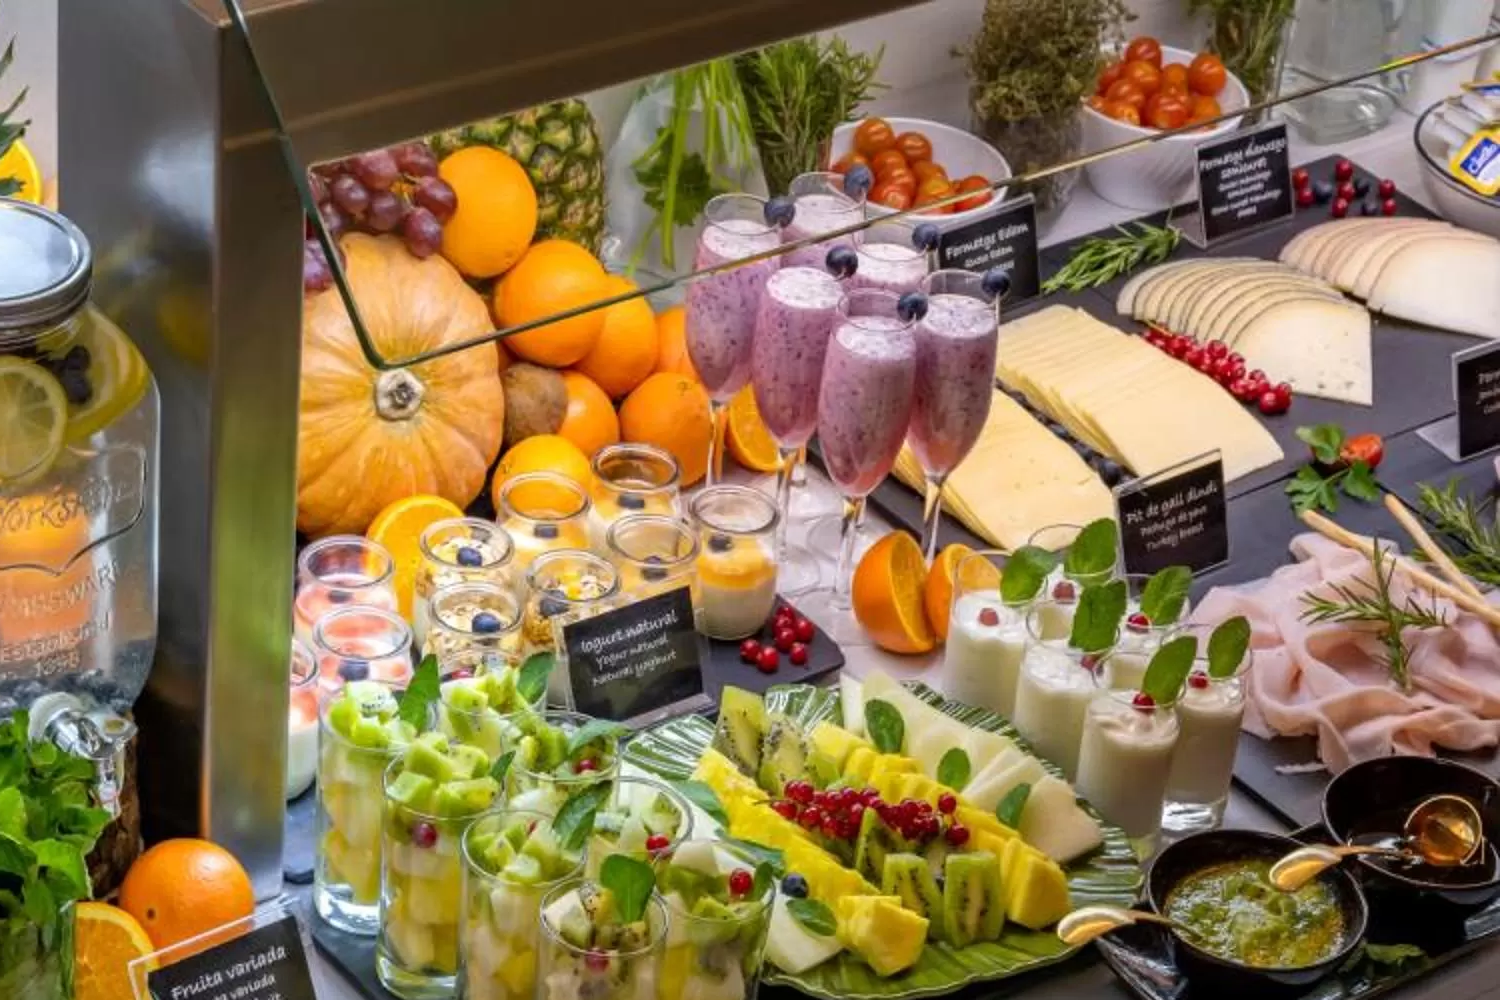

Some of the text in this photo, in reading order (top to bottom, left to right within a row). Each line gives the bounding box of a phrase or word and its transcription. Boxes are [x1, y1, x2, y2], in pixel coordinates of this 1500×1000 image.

[624, 608, 679, 640] natural
[225, 944, 288, 980] variada
[229, 972, 276, 1000] variada
